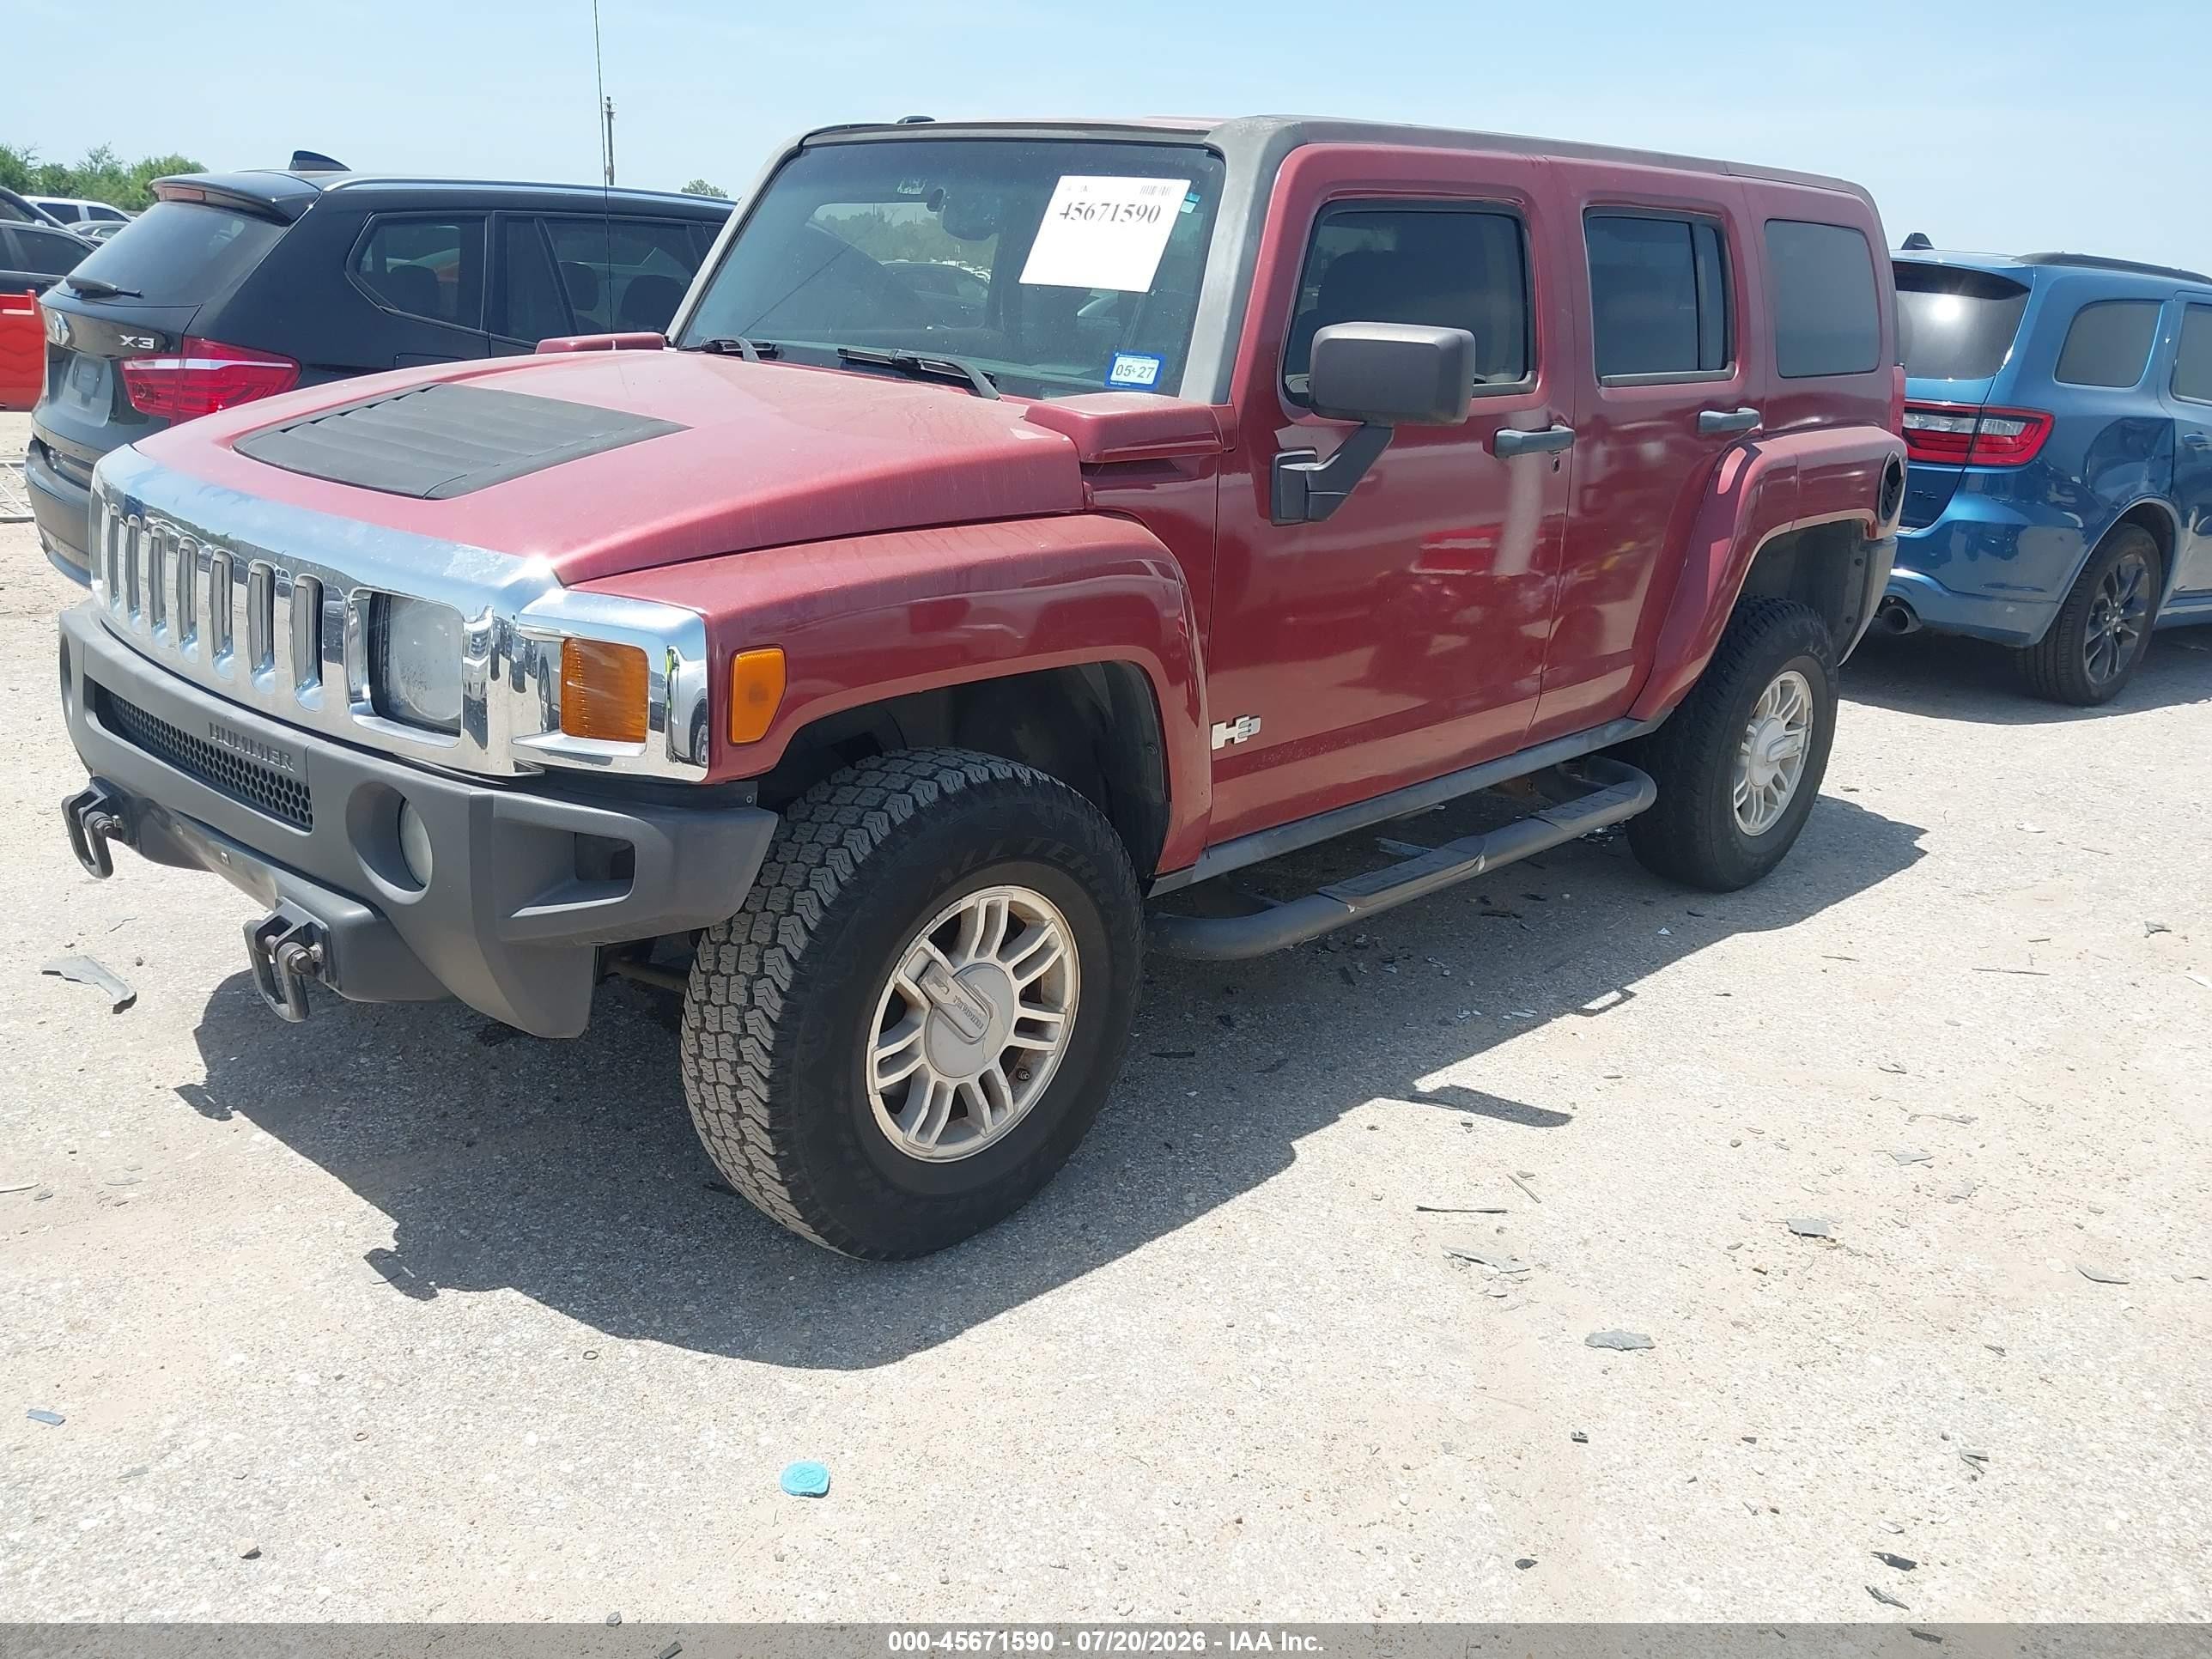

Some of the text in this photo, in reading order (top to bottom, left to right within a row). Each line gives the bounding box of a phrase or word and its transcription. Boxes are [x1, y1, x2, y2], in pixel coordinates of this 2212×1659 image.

[1059, 202, 1162, 224] 45671590
[118, 334, 155, 349] X3
[1211, 714, 1261, 750] H3
[209, 721, 295, 773] HUMMER
